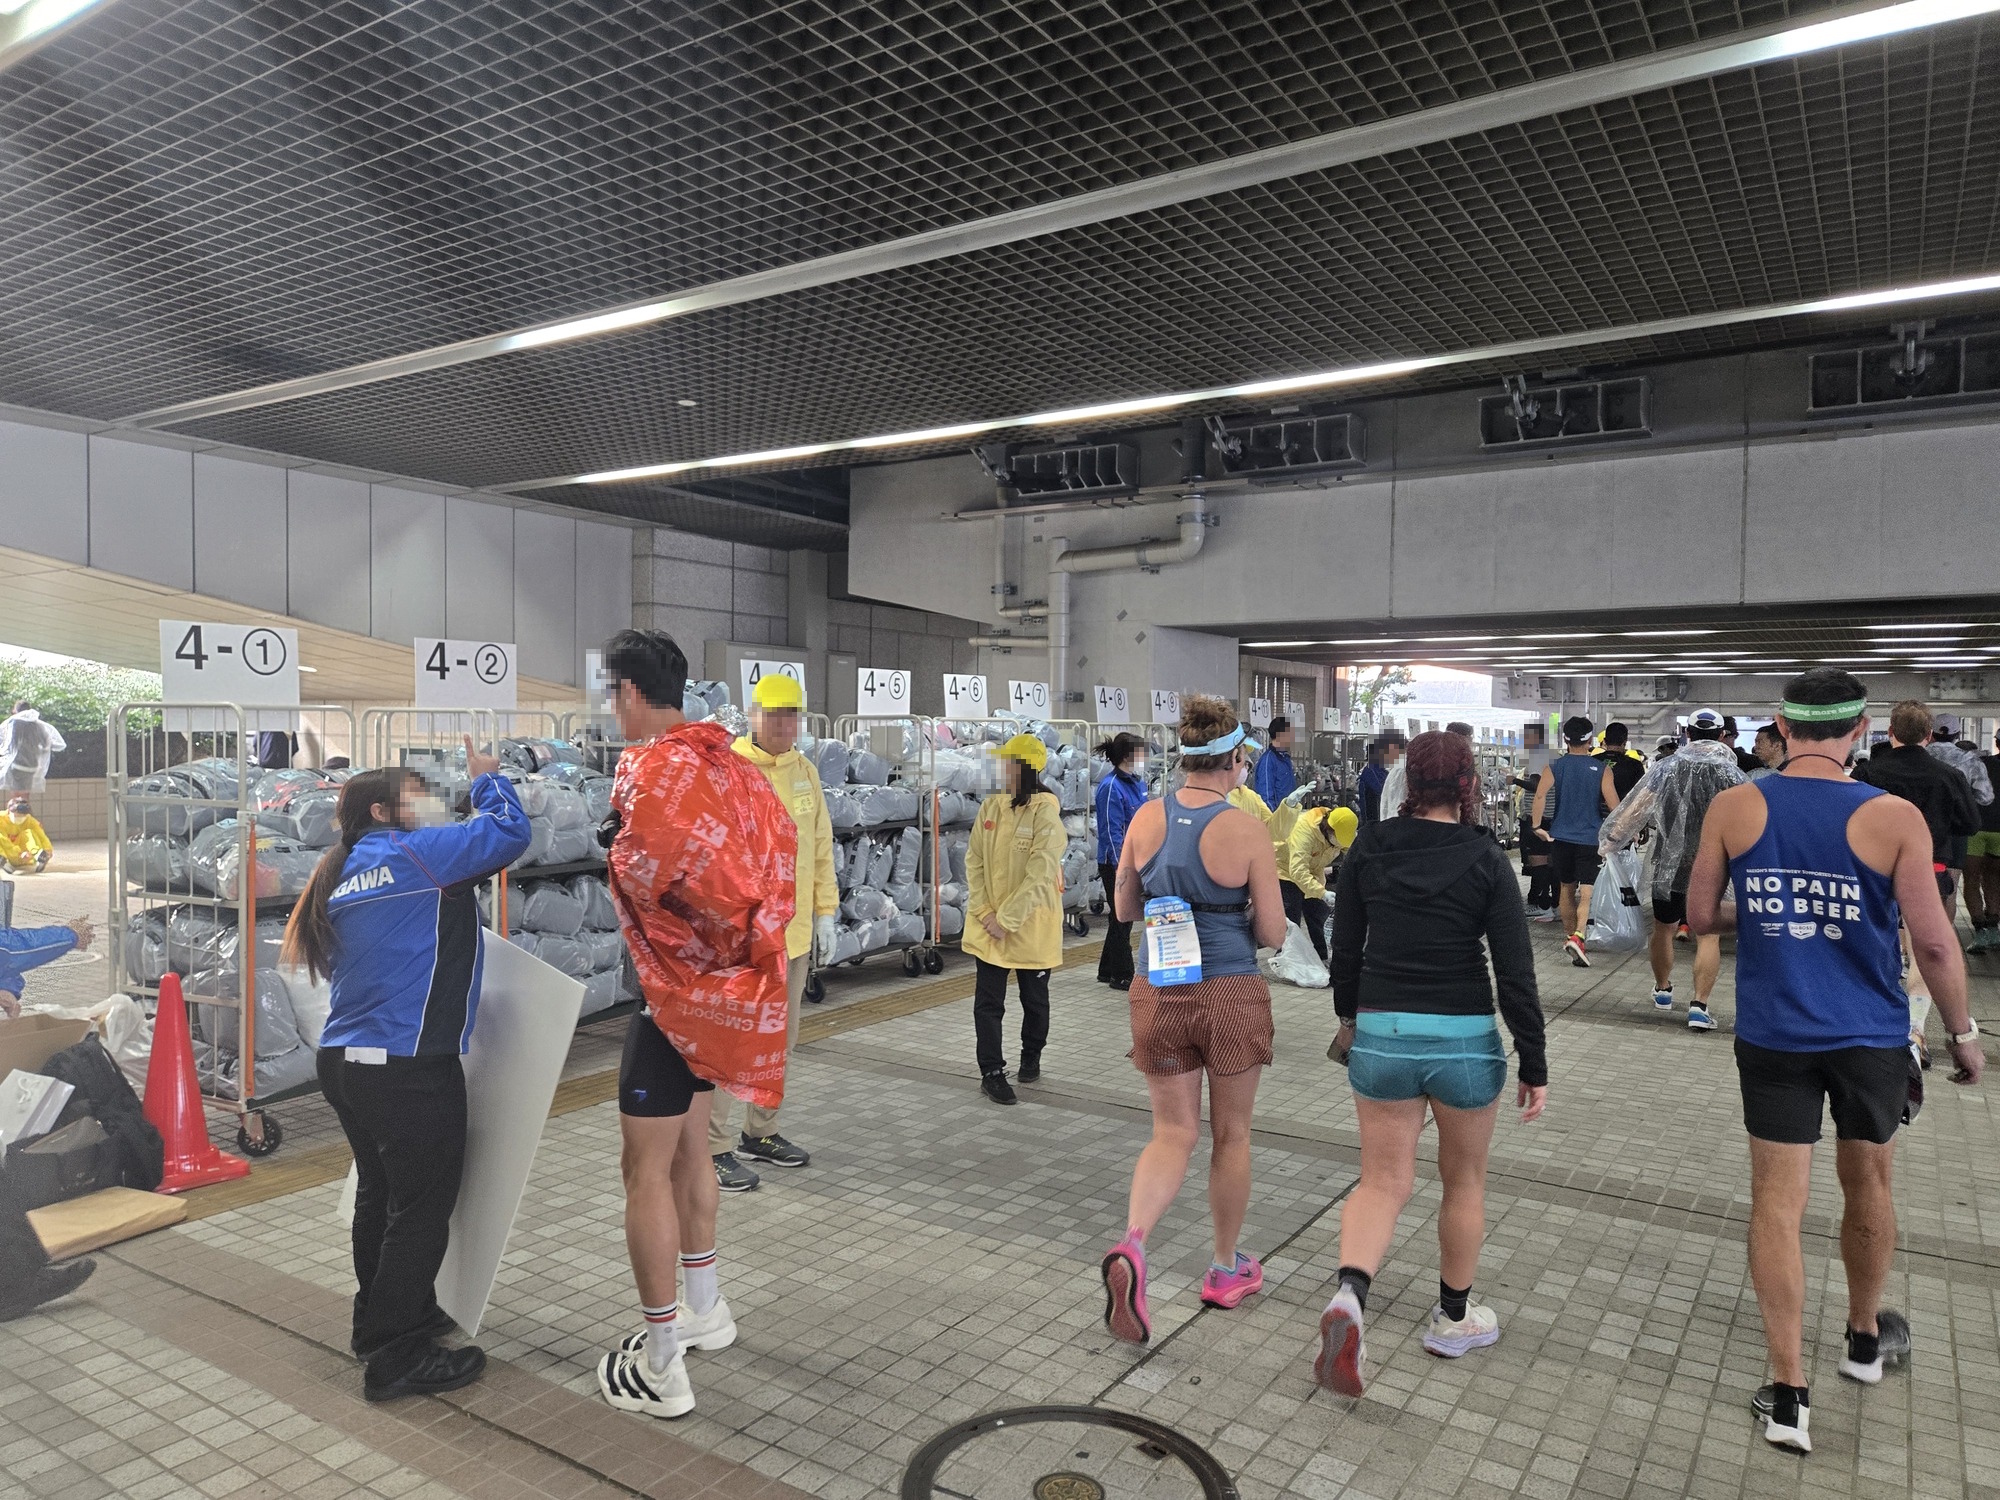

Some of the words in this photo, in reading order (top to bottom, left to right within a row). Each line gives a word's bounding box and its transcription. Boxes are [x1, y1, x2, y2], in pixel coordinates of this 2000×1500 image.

[1746, 876, 1782, 893] NO
[1792, 877, 1860, 901] PAIN
[1747, 897, 1784, 914] NO
[1793, 897, 1861, 921] BEER
[737, 1066, 786, 1082] Sports
